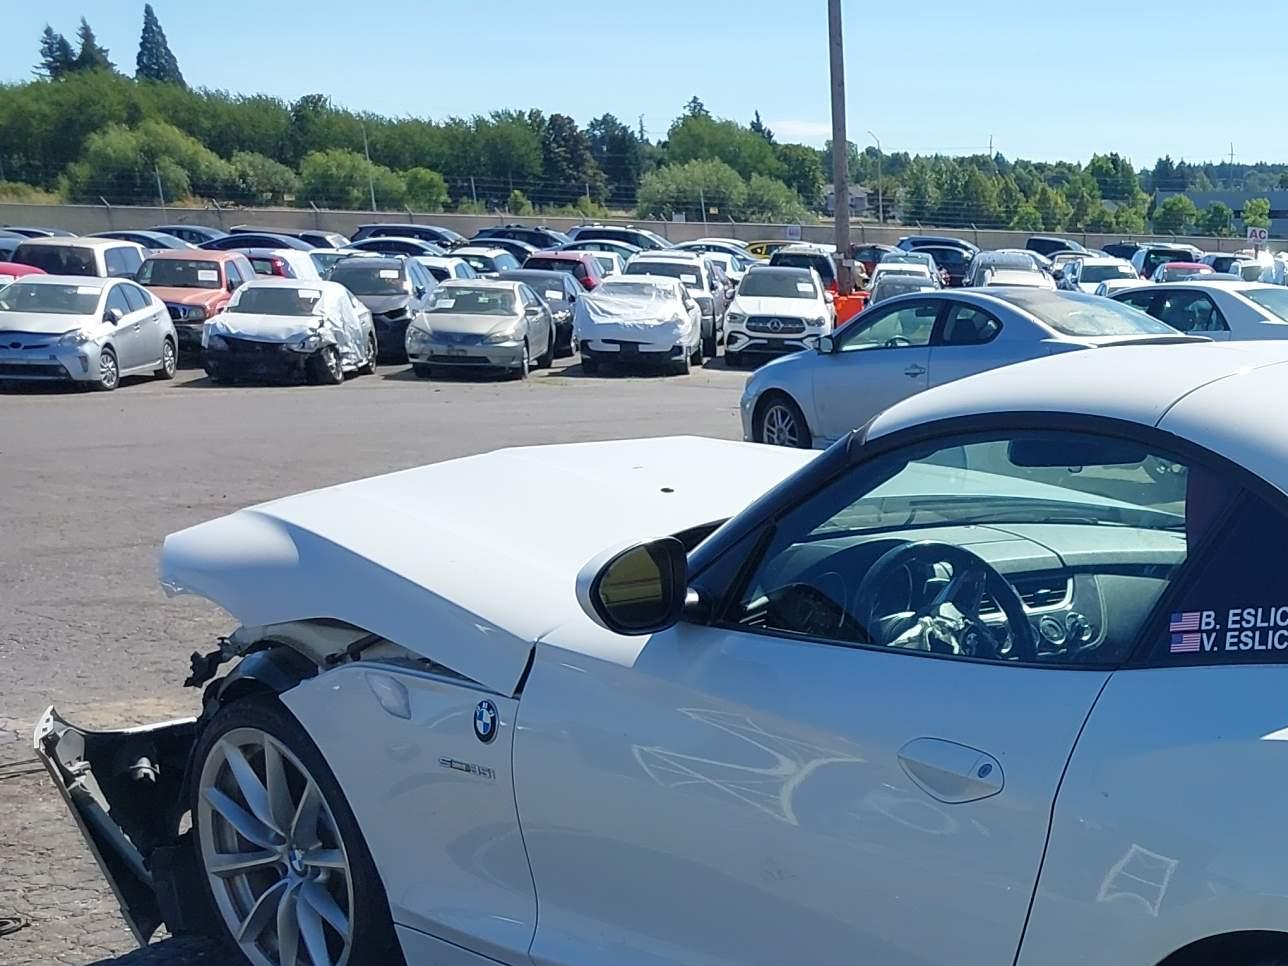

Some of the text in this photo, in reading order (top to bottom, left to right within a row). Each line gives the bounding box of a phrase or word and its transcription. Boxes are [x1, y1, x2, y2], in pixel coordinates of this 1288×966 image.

[1249, 229, 1267, 240] AC
[1200, 610, 1220, 631] B.
[1201, 632, 1218, 651] V.
